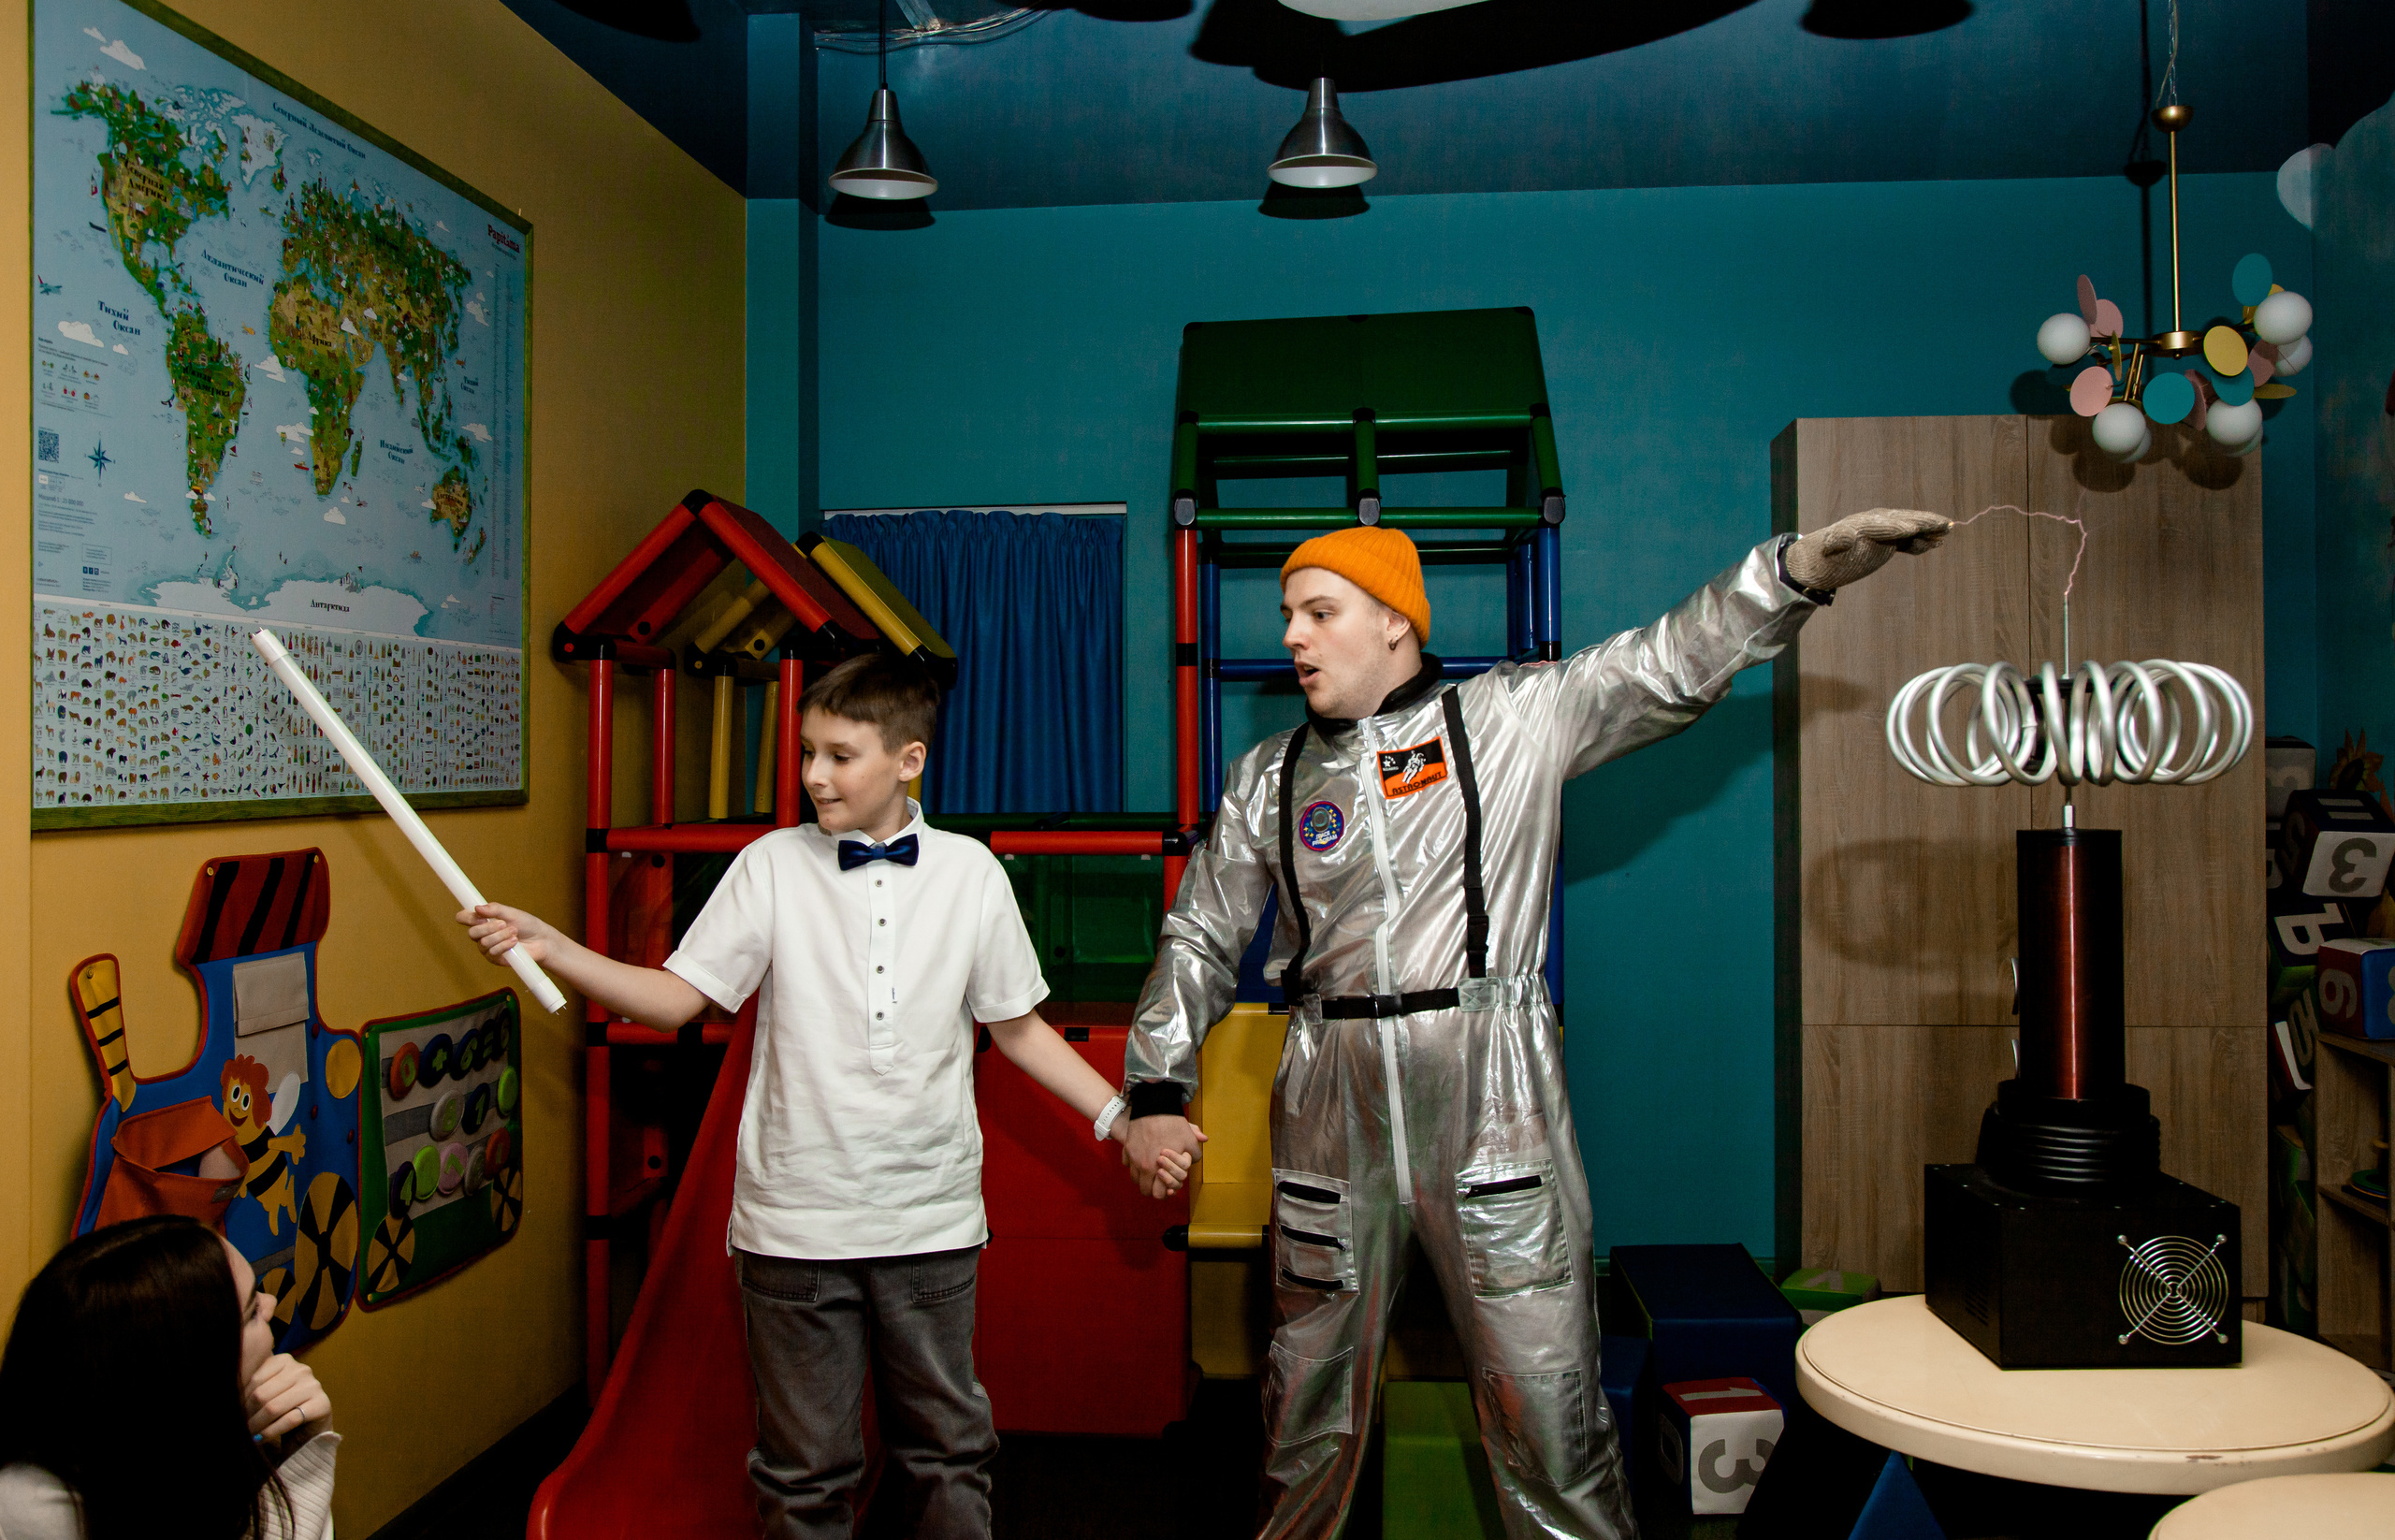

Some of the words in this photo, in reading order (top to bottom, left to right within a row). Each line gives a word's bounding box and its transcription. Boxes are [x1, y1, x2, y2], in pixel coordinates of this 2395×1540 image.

[272, 102, 307, 128] Северный
[346, 143, 366, 159] Океан
[201, 249, 264, 285] Атлантический
[224, 272, 247, 287] Океан
[97, 299, 129, 321] Тихий
[112, 320, 140, 335] Океан
[307, 330, 332, 347] Африка
[196, 381, 230, 397] Америка
[379, 439, 414, 455] Индийский
[387, 451, 405, 465] Океан
[310, 599, 350, 612] Антарктида
